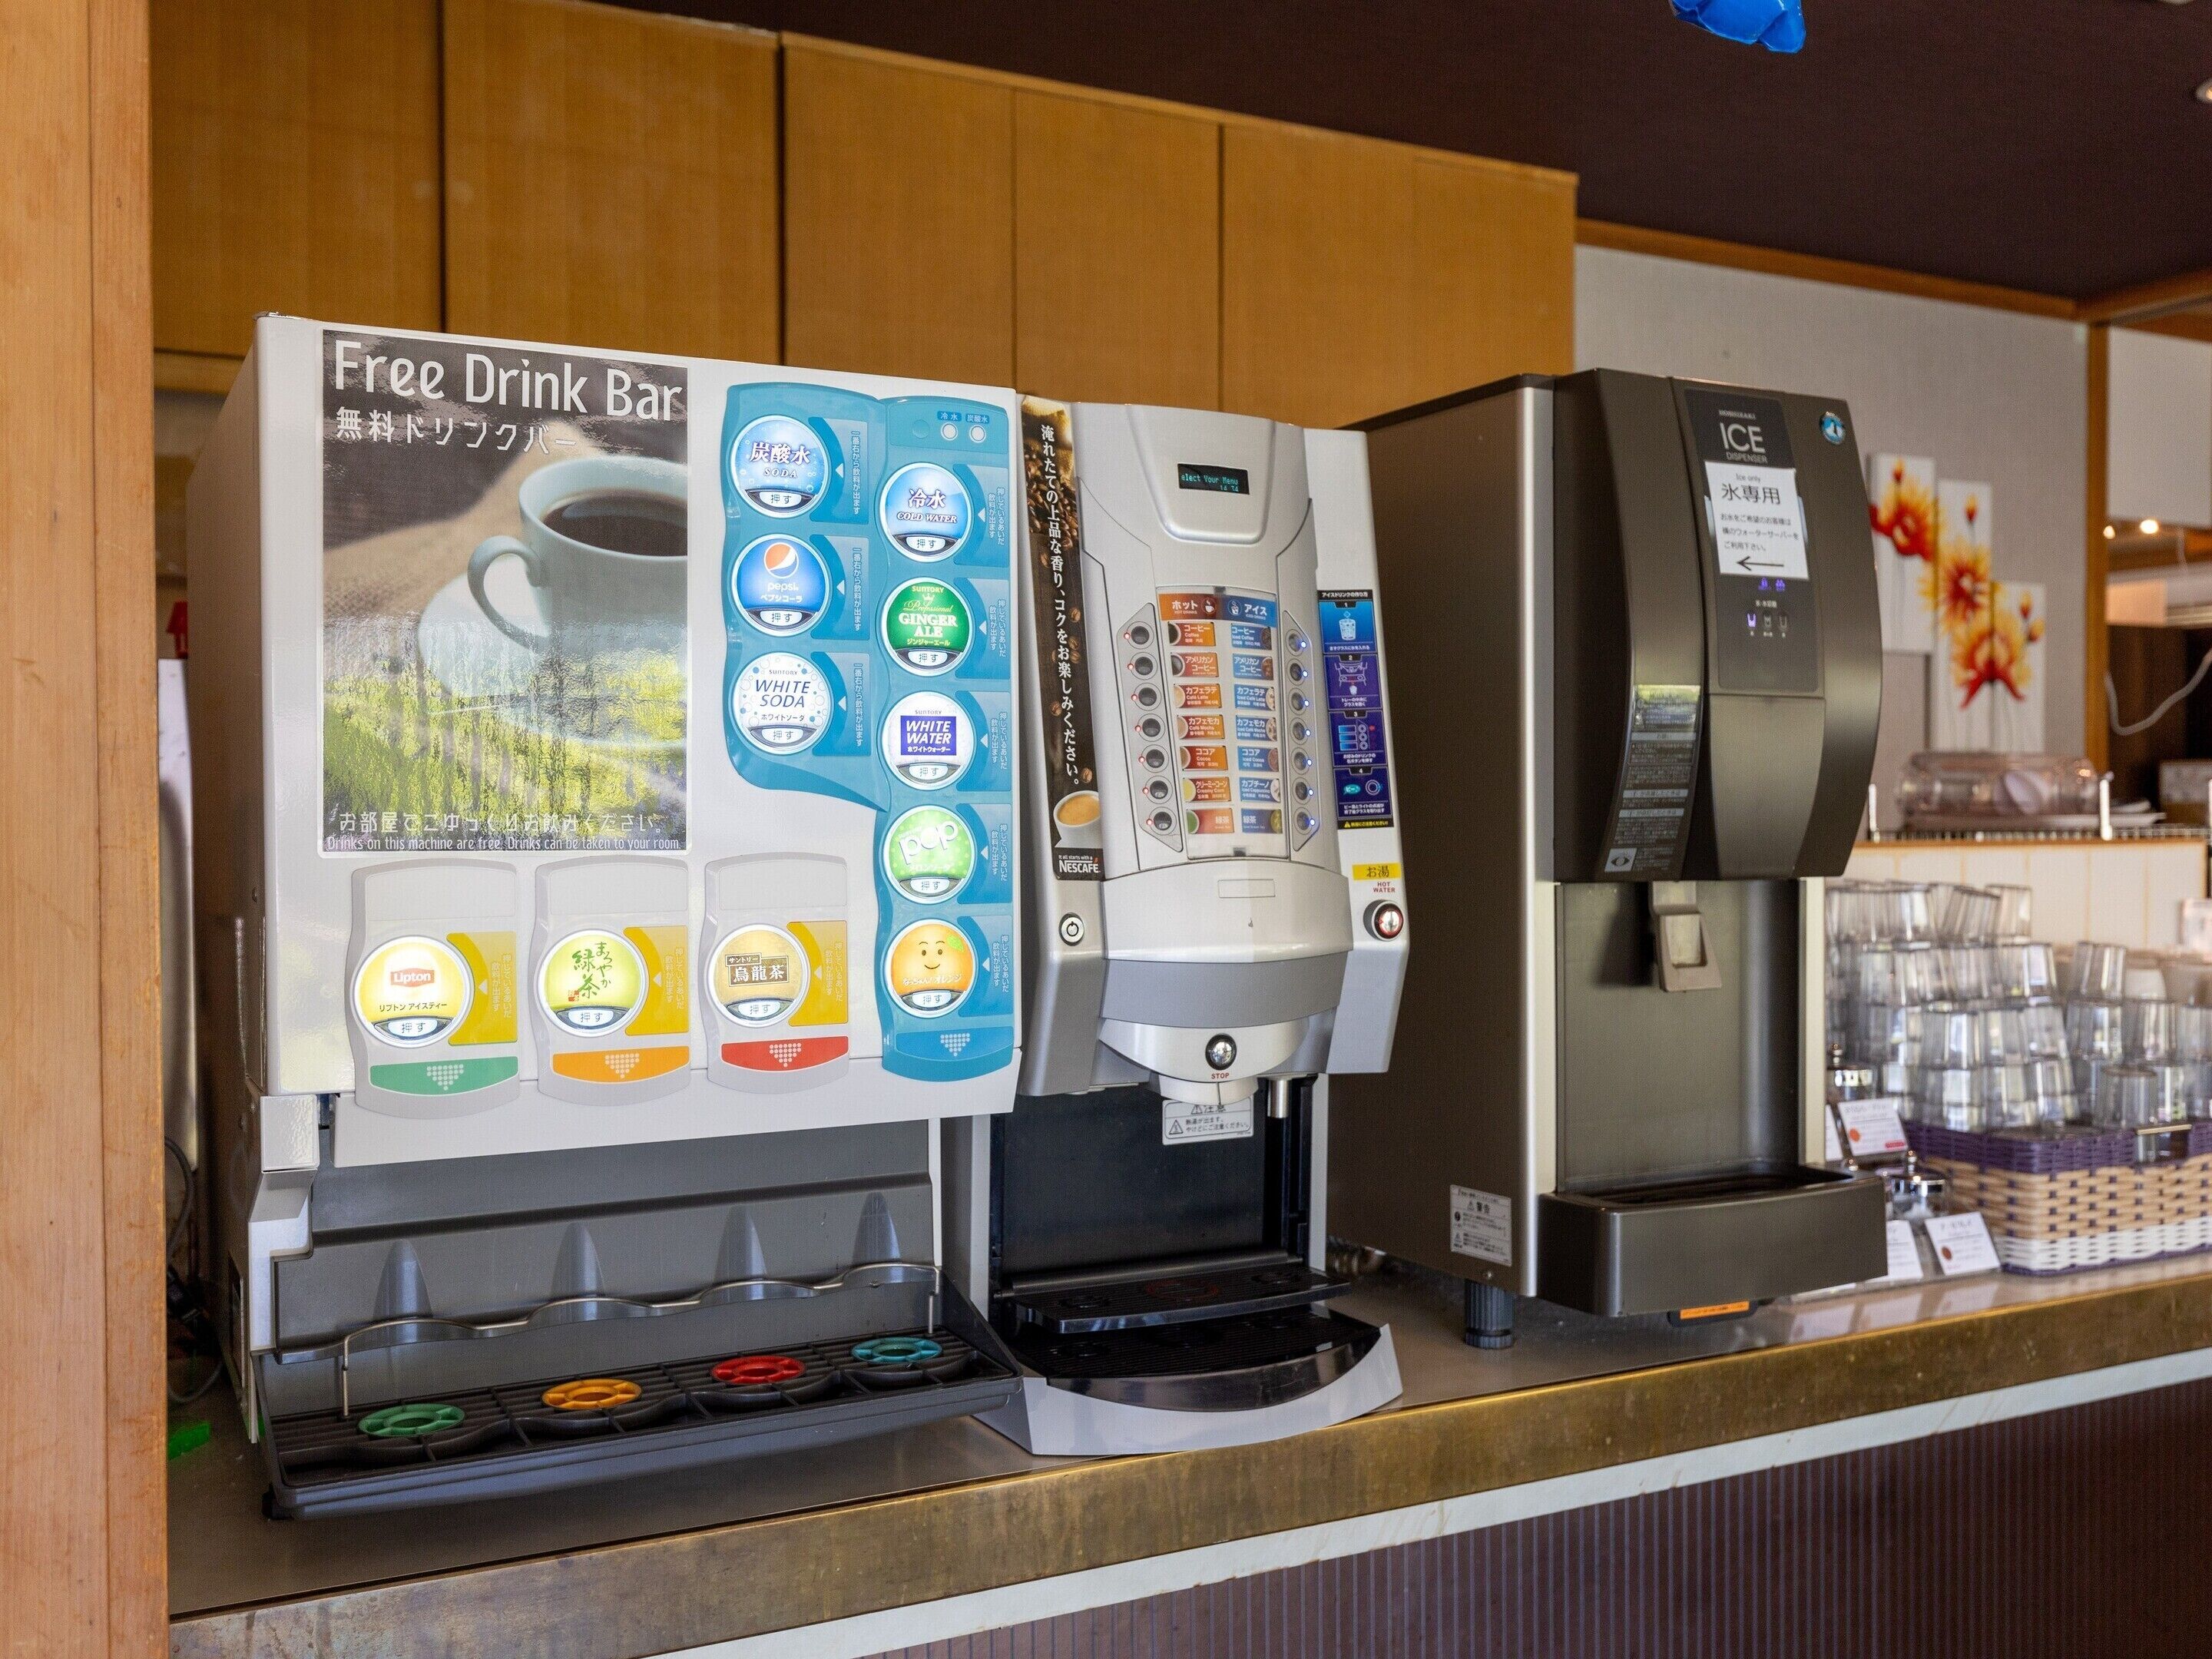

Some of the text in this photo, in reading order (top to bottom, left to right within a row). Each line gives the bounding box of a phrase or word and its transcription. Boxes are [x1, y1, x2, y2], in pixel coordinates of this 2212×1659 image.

[335, 339, 683, 421] Free Drink Bar
[941, 412, 959, 421] 冷水
[967, 414, 988, 424] 炭酸水
[336, 406, 577, 455] 無料ドリンクバー
[1719, 422, 1767, 454] ICE
[749, 441, 811, 465] 炭酸水
[763, 468, 799, 478] SODA
[852, 431, 861, 515] 一番右から飲料が出ます
[908, 488, 946, 510] 冷水
[1721, 482, 1781, 505] 氷専用
[770, 495, 792, 505] 押す
[896, 511, 959, 524] COLD WATER
[916, 538, 937, 548] 押す
[767, 581, 797, 593] pepsi
[853, 548, 862, 631] 一番右から飲料が出ます
[760, 593, 804, 604] ペプシコーラ
[1041, 424, 1078, 786] 淹れたての上品な香り、コクをお楽しみください。
[1171, 600, 1198, 611] ホット
[1244, 603, 1267, 616] アイス
[771, 612, 793, 623] 押す
[898, 612, 959, 628] GINGER
[914, 625, 944, 638] ALE
[1231, 626, 1256, 635] コーヒー
[907, 637, 951, 646] ジンジャーエール
[919, 653, 938, 663] 押す
[1233, 656, 1260, 665] アメリカン
[1240, 664, 1262, 674] コーヒー
[756, 679, 812, 694] WHITE
[1185, 686, 1217, 695] カフェラテ
[1237, 686, 1266, 696] カフェラテ
[759, 694, 805, 708] SODA
[854, 663, 863, 747] 一番右から飲料が出ます
[761, 713, 805, 723] ホワイトソーダ
[1237, 718, 1266, 727] カフェモカ
[906, 720, 950, 733] WHITE
[773, 730, 794, 740] 押す
[906, 732, 952, 744] WATER
[1242, 748, 1260, 757] ココア
[919, 767, 939, 777] 押す
[1241, 780, 1270, 788] カプチーノ
[327, 836, 363, 850] Drinks
[367, 839, 381, 849] on
[385, 837, 406, 849] this
[406, 837, 455, 850] machine
[456, 839, 475, 850] are
[508, 837, 541, 850] Drinks
[544, 839, 565, 850] can
[567, 837, 578, 849] be
[581, 837, 611, 850] taken
[614, 838, 624, 849] to
[628, 839, 651, 851] your
[654, 839, 681, 849] room.
[1366, 866, 1389, 879] お湯
[594, 942, 613, 988] まろやか
[392, 971, 432, 985] Lipton
[571, 949, 601, 999] 緑茶
[379, 1001, 448, 1012] リプトン アイスティー
[750, 1004, 771, 1015] 押す
[580, 1012, 603, 1023] 押す
[401, 1022, 426, 1034] 押す
